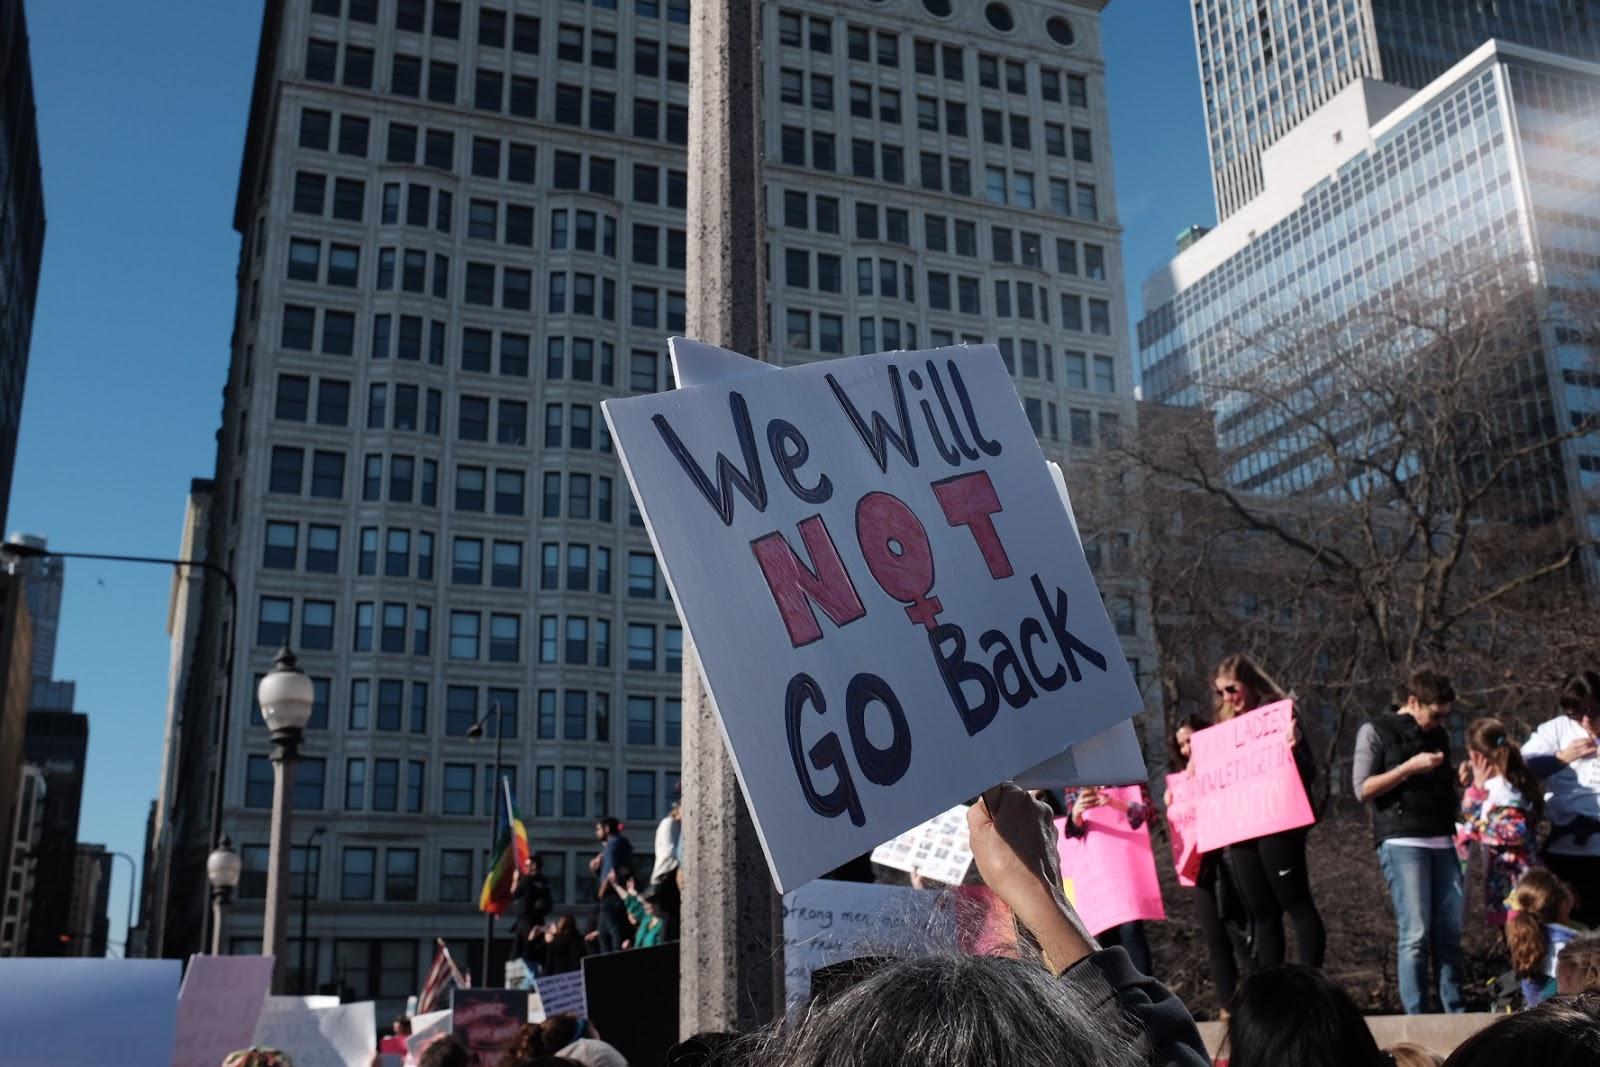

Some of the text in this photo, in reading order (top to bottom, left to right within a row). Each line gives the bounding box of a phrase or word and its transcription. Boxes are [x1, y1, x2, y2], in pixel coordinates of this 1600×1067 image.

[652, 360, 1003, 526] We Will
[750, 470, 1014, 649] NOT
[928, 573, 1108, 737] Back
